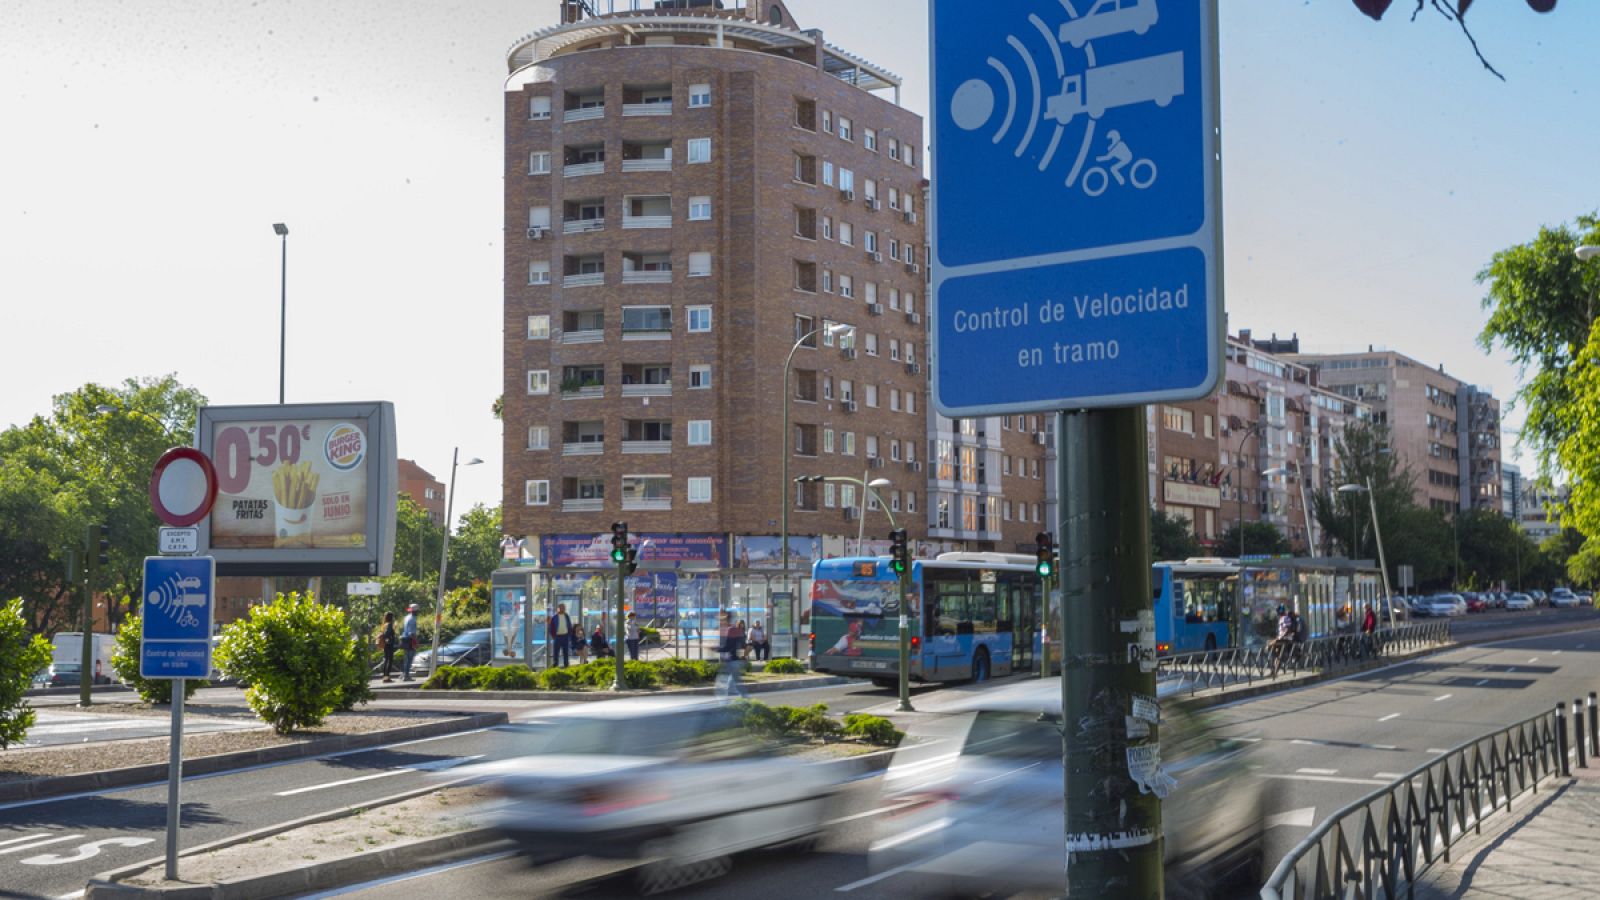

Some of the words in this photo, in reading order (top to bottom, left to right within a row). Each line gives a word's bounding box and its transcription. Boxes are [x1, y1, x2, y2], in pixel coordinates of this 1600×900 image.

[953, 302, 1028, 333] Control
[1039, 299, 1065, 324] de
[1073, 283, 1189, 320] Velocidad
[1018, 347, 1043, 367] en
[1053, 339, 1120, 364] tramo
[328, 432, 361, 449] BURGER
[331, 440, 361, 460] KING
[232, 499, 268, 511] PATATAS
[323, 503, 351, 518] JUNIO
[236, 509, 264, 520] FRITAS
